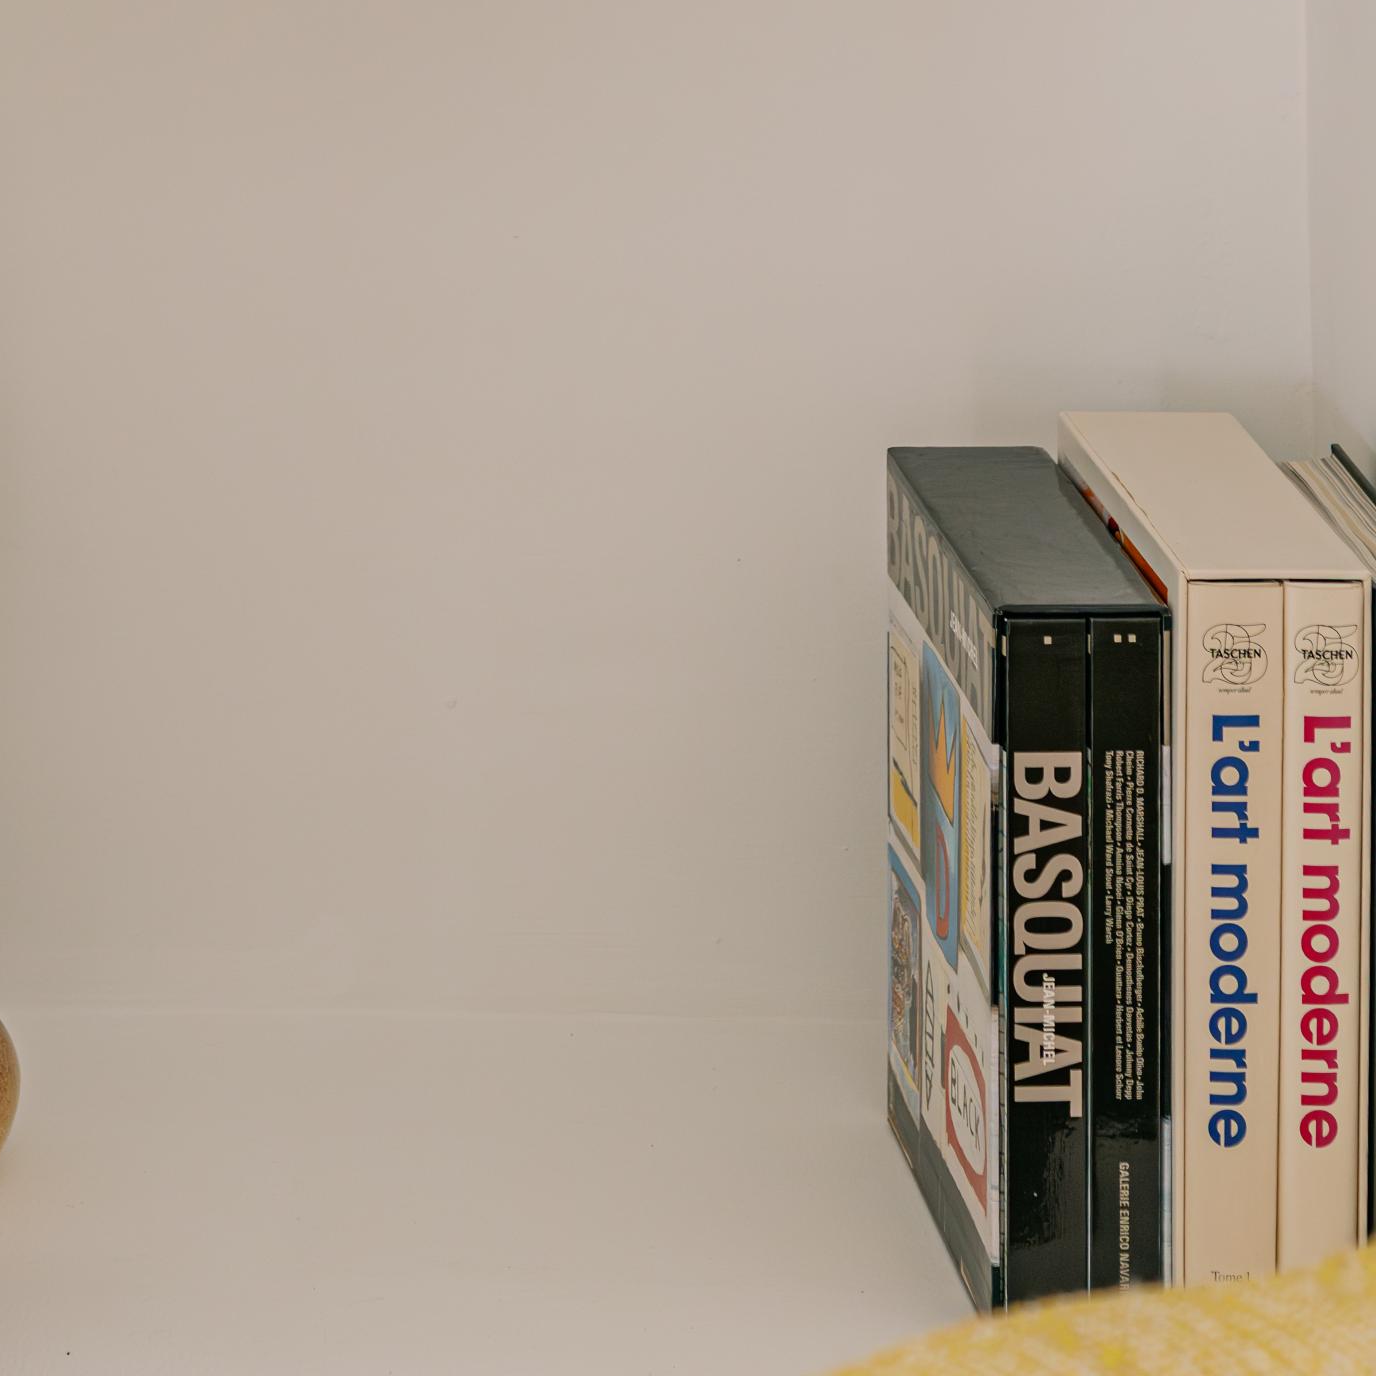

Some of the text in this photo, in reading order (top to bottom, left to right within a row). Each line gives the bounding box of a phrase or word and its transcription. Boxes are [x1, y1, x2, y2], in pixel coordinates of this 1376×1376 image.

[1210, 648, 1262, 659] TASCHEN
[1302, 649, 1353, 660] TASCHEN
[1210, 714, 1261, 845] L'art
[1301, 715, 1352, 845] L'art
[1012, 751, 1084, 1118] BASQUIAT JEAN-MICHEL
[1207, 862, 1259, 1148] moderne
[1299, 864, 1351, 1149] moderne
[1119, 1161, 1129, 1294] GALERIE ENRICO NAVAR
